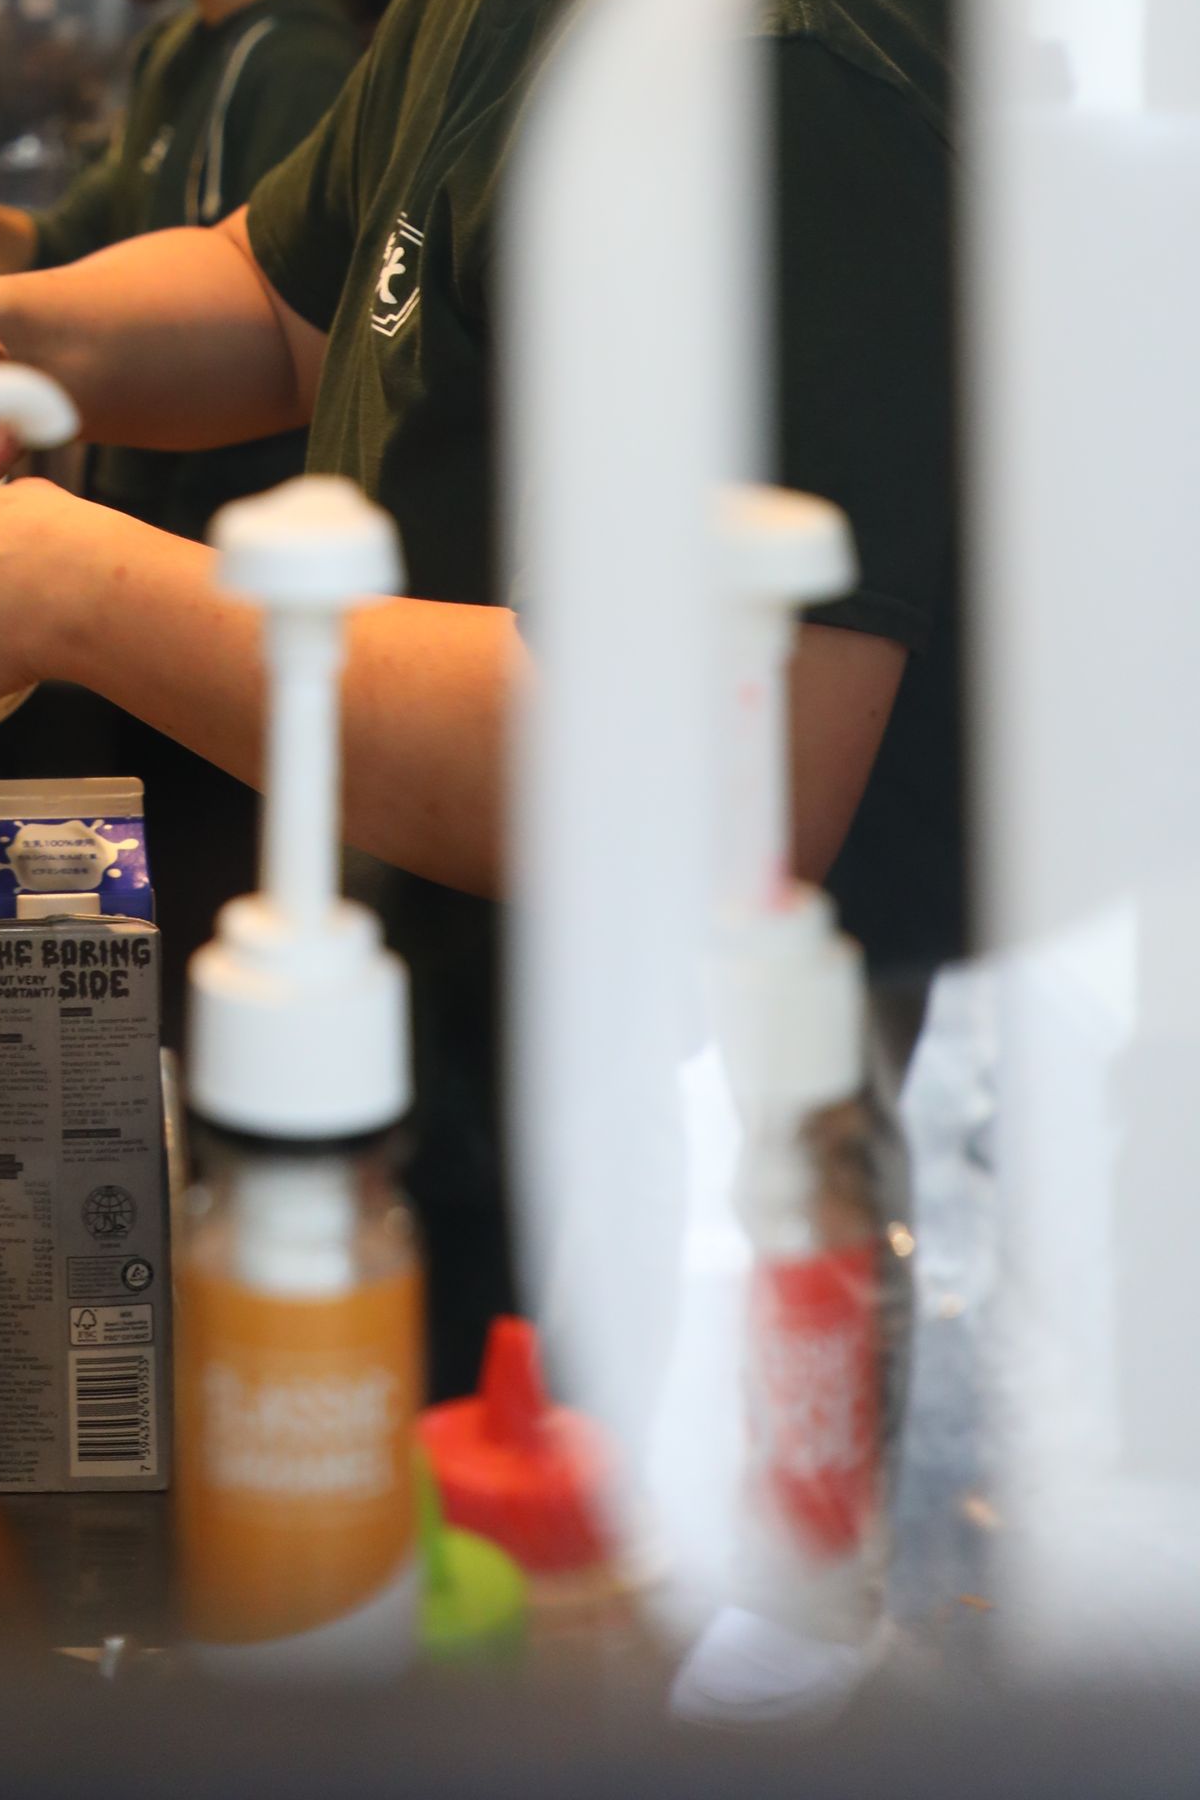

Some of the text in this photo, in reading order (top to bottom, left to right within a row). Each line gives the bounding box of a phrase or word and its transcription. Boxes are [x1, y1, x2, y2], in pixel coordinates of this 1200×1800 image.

[41, 938, 150, 969] BORING
[18, 974, 47, 986] VERY
[58, 970, 129, 1000] SIDE
[140, 1464, 151, 1472] 7
